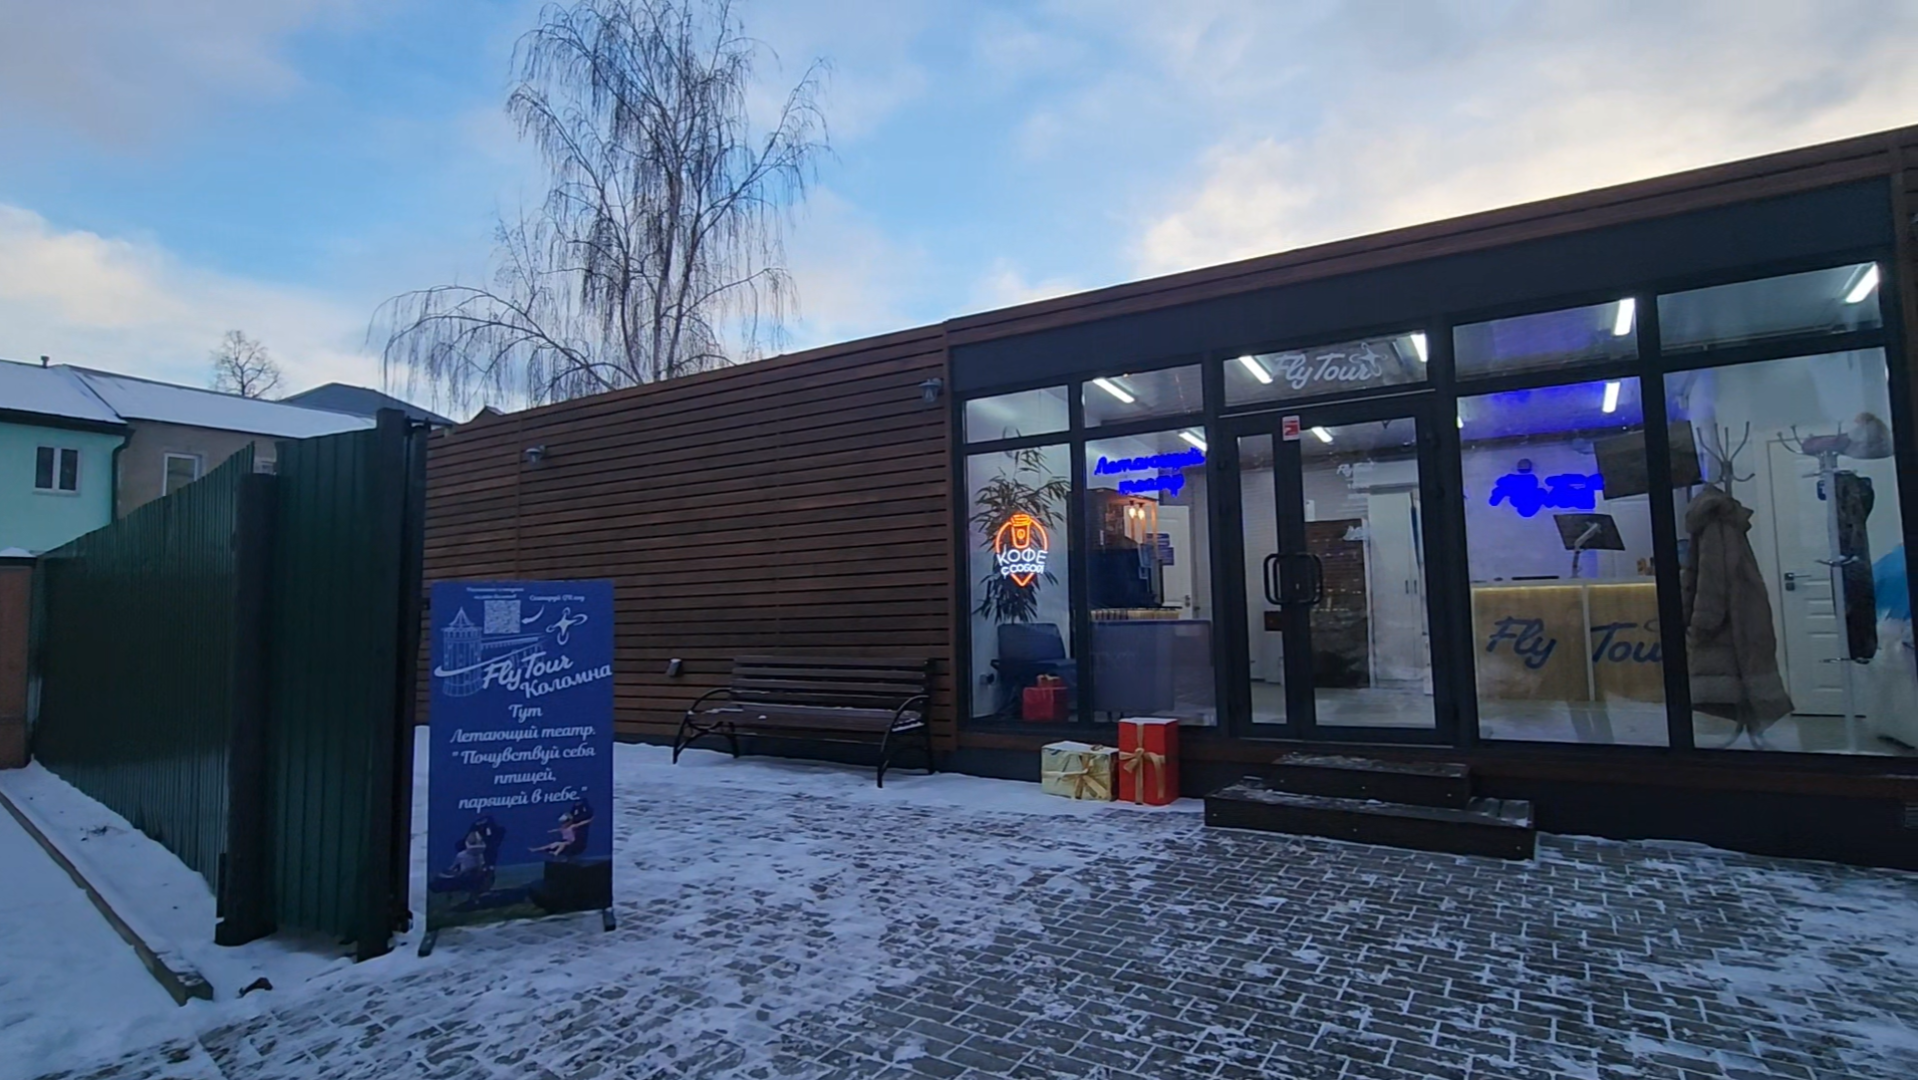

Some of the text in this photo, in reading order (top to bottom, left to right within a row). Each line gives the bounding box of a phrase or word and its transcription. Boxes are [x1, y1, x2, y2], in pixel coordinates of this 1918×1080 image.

[1273, 352, 1372, 389] Fly Tour
[996, 545, 1048, 566] КОФЕ
[1485, 616, 1663, 669] Fly Tou
[482, 651, 574, 691] Fly Tour
[519, 664, 613, 699] Коломна
[508, 703, 543, 723] Тут
[449, 725, 597, 743] Летающий театр.
[562, 742, 596, 758] себя
[493, 768, 557, 785] птицей,
[458, 791, 528, 813] парящей
[531, 788, 543, 804] в
